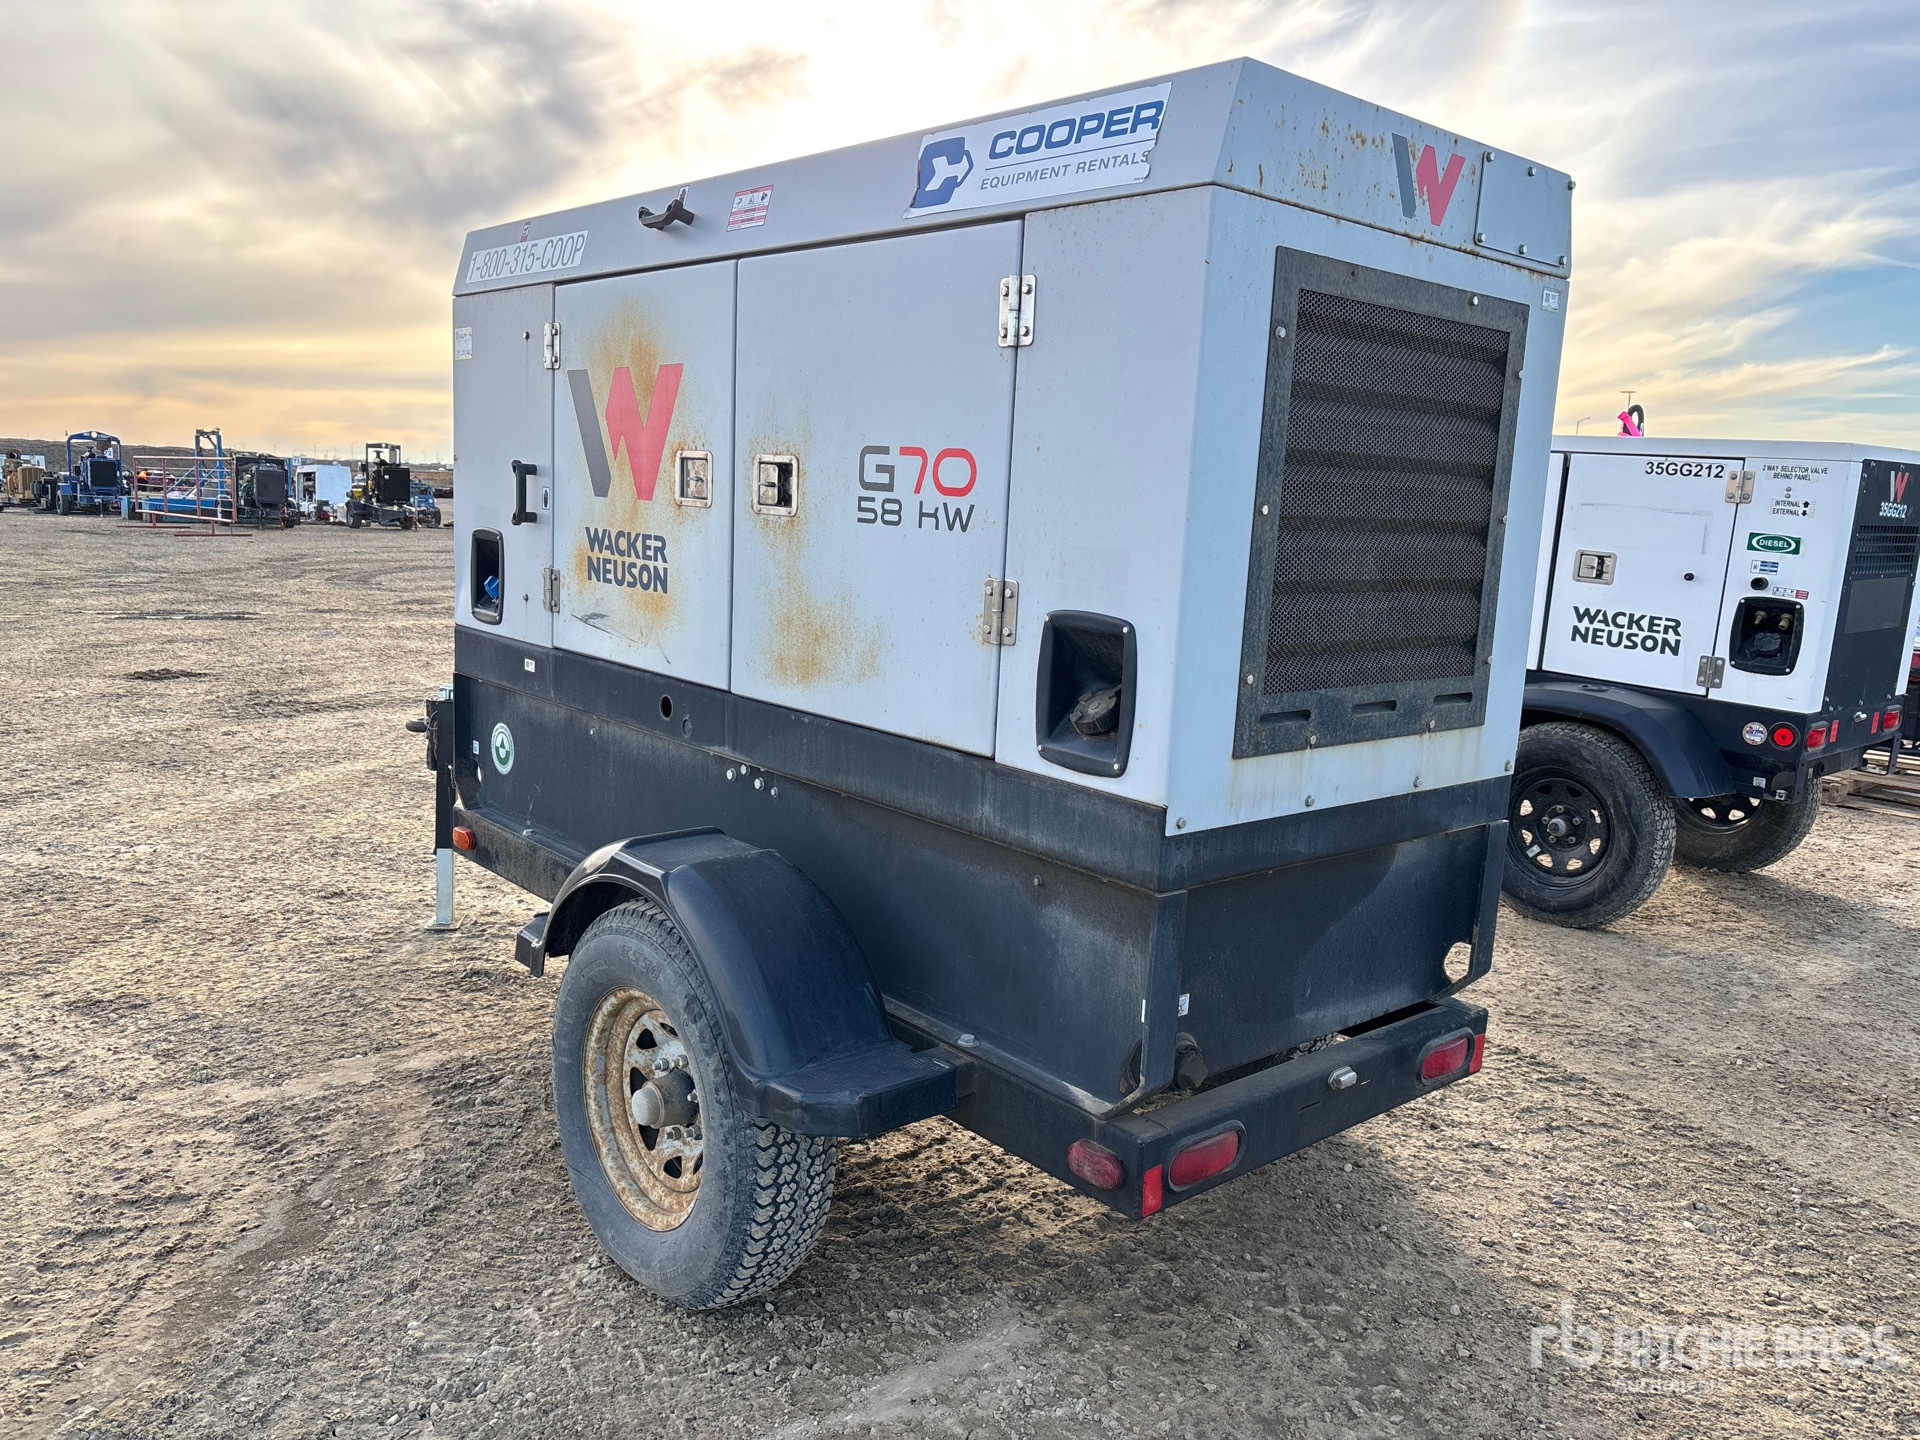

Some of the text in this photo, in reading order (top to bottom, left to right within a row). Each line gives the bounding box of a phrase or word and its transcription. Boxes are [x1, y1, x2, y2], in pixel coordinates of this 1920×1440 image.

[988, 100, 1164, 160] COOPER
[980, 150, 1150, 190] EQUIPMENT RENTALS
[469, 233, 586, 281] 1-800-315-COOP
[858, 445, 977, 497] G70
[1645, 461, 1725, 479] 35GG212
[1762, 464, 1828, 475] 2 WAY SELECTOR VALVE
[1772, 472, 1812, 481] BEHIND PANEL
[857, 496, 903, 527] 58
[1772, 507, 1800, 516] EXTERNAL
[1774, 500, 1801, 508] INTERNAL
[1879, 501, 1908, 519] 35GG212
[585, 526, 668, 564] WACKER
[1758, 539, 1790, 548] DIESEL
[587, 555, 668, 595] NEUSON
[1572, 605, 1682, 637] WACKER
[1570, 624, 1681, 657] NEUSON
